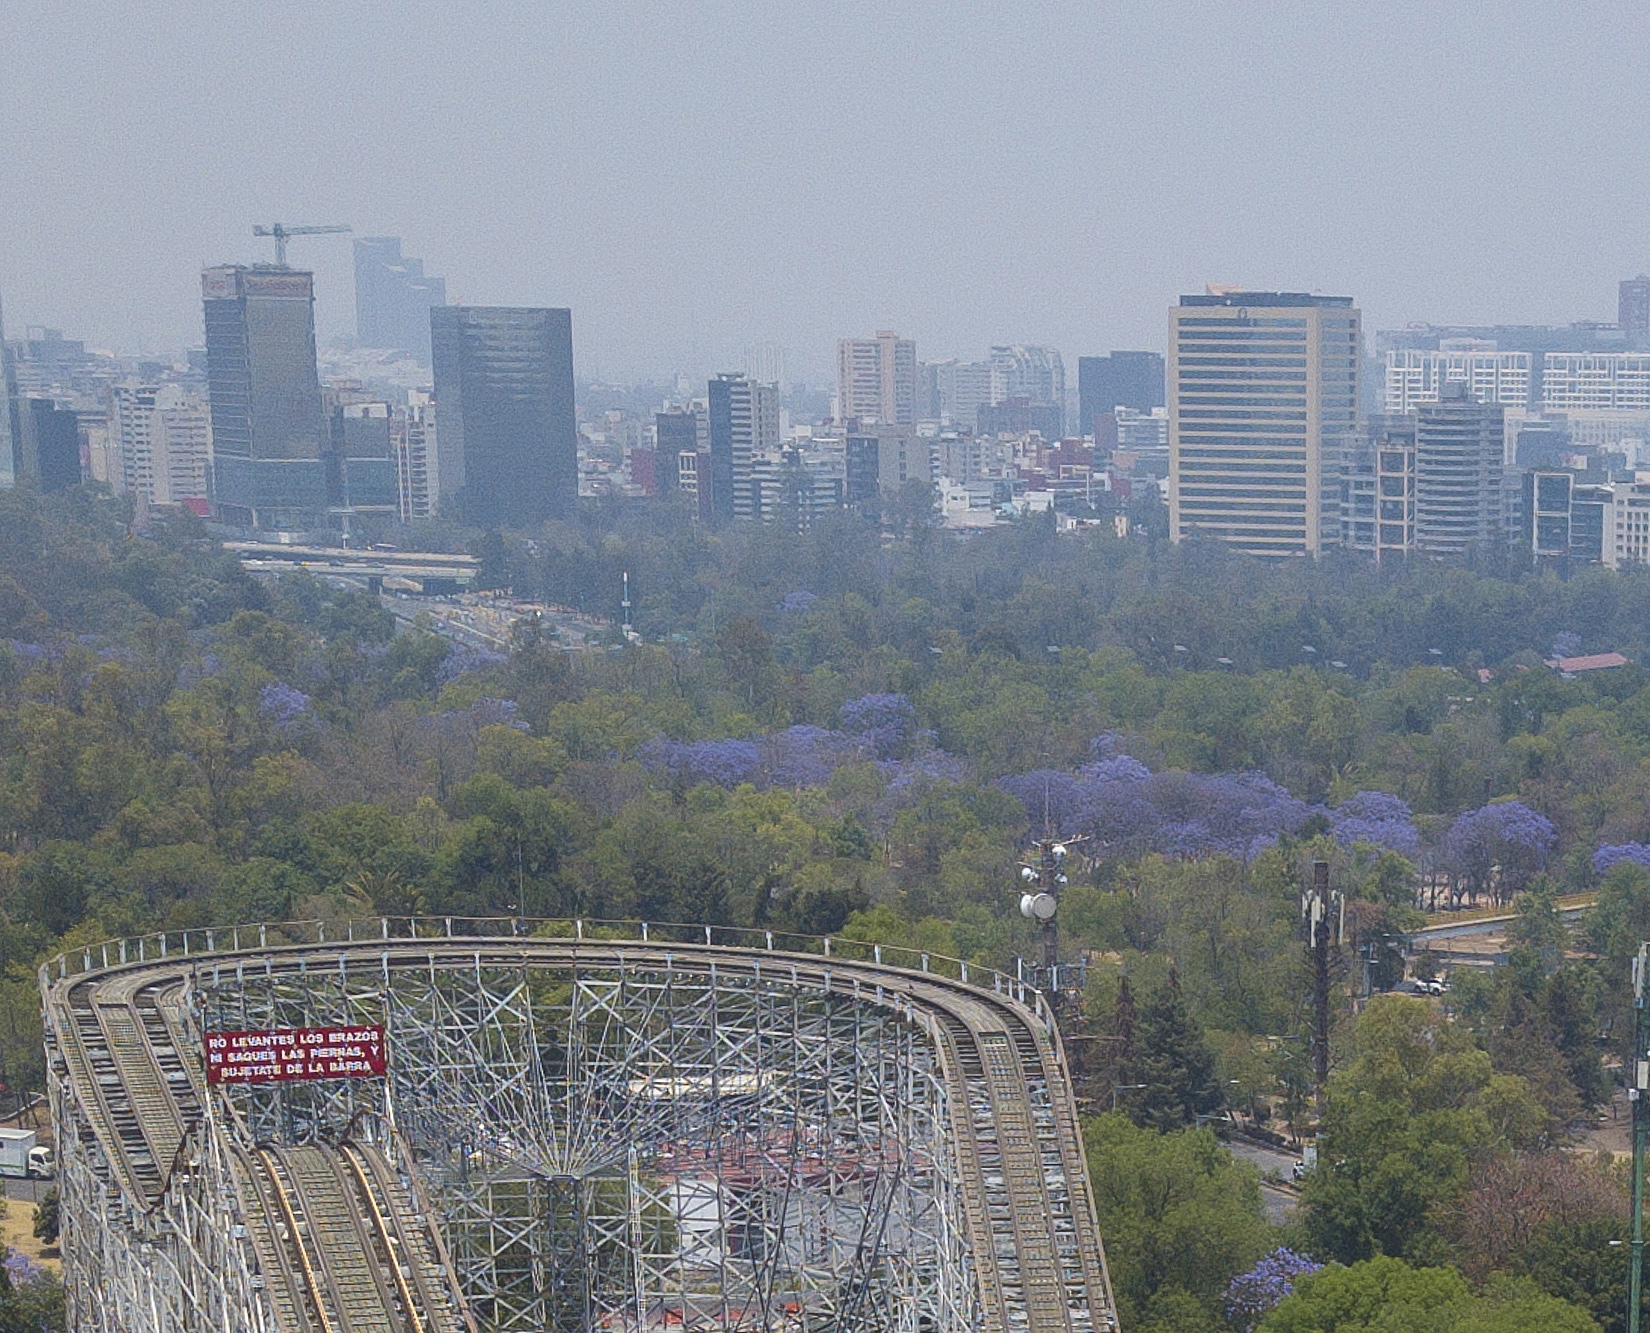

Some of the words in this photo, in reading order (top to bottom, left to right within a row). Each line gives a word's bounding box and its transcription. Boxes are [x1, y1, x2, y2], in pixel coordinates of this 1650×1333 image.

[232, 1035, 294, 1047] LEVANTES
[300, 1033, 323, 1043] LOS
[329, 1031, 379, 1042] BRAZOS
[228, 1052, 276, 1062] SAQUES
[281, 1049, 305, 1058] LAS
[370, 1046, 379, 1055] Y
[286, 1064, 303, 1073] DE
[308, 1063, 324, 1072] LA
[330, 1061, 371, 1071] BARRA
